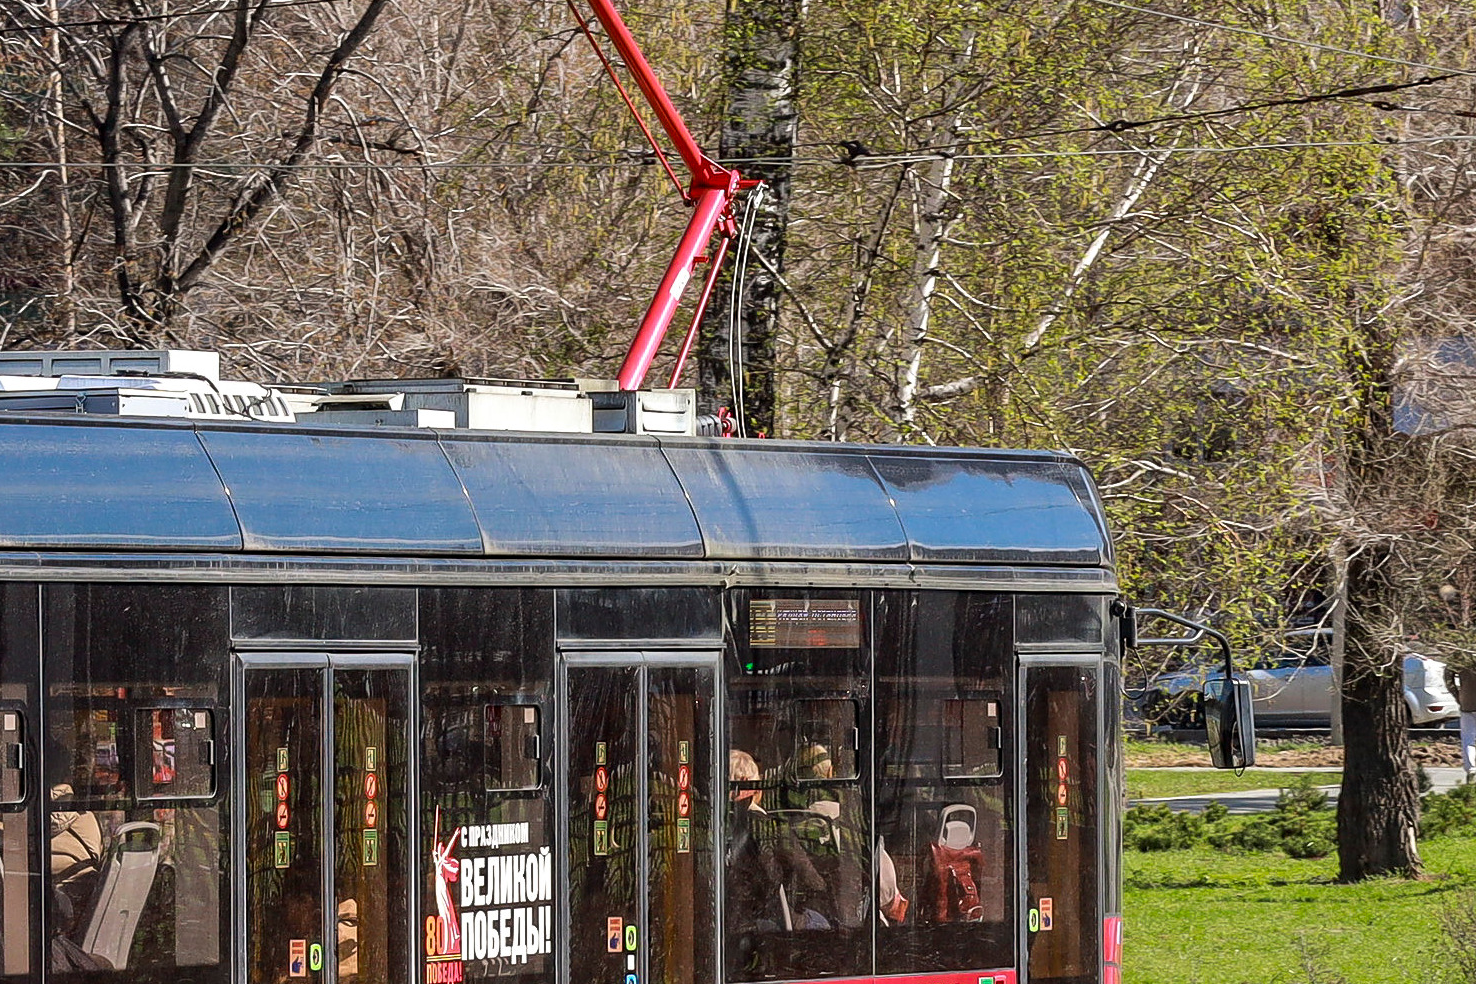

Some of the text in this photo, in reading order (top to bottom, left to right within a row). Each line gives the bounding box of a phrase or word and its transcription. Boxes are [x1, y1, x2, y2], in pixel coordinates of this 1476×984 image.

[460, 822, 529, 849] С ПРАЗДНИКОМ
[460, 846, 552, 907] ВЕЛИКОЙ
[426, 915, 446, 956] 80
[460, 905, 552, 965] ПОБЕДЫ!
